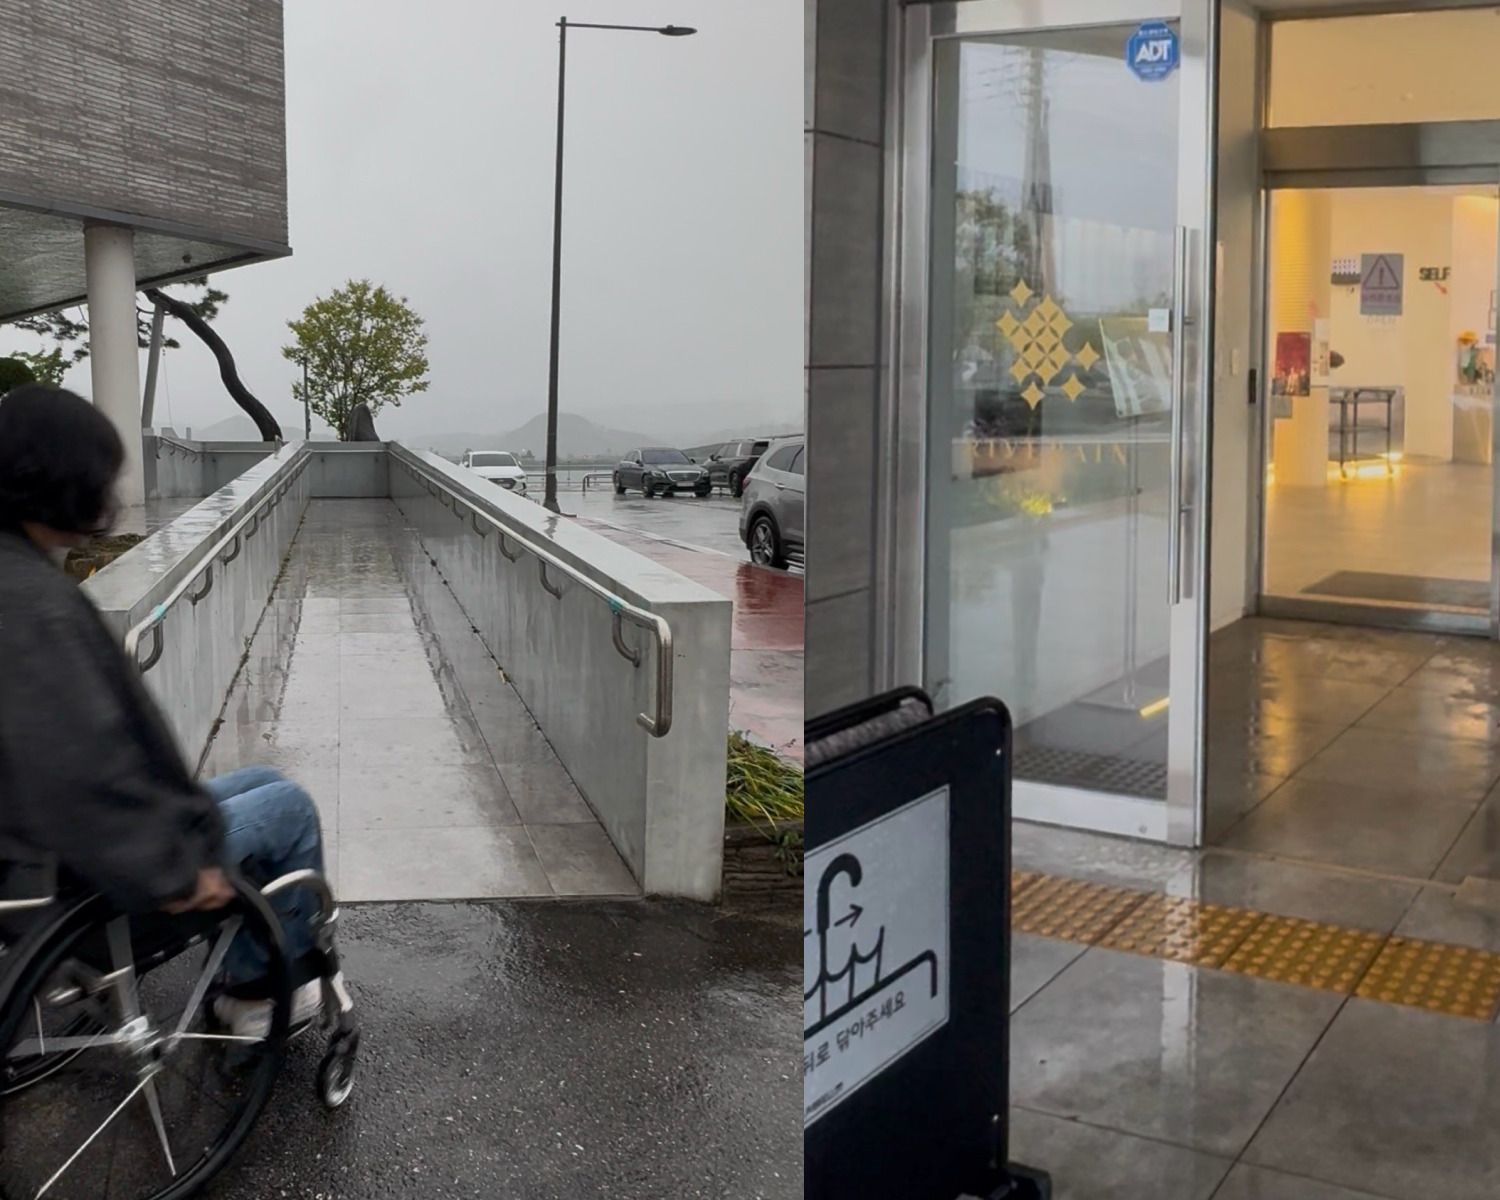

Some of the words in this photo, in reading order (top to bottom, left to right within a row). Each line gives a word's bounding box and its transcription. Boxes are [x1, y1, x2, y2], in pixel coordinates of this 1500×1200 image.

[1135, 39, 1172, 63] ADT
[1419, 267, 1451, 281] SELF
[836, 990, 906, 1053] 닦아주세요
